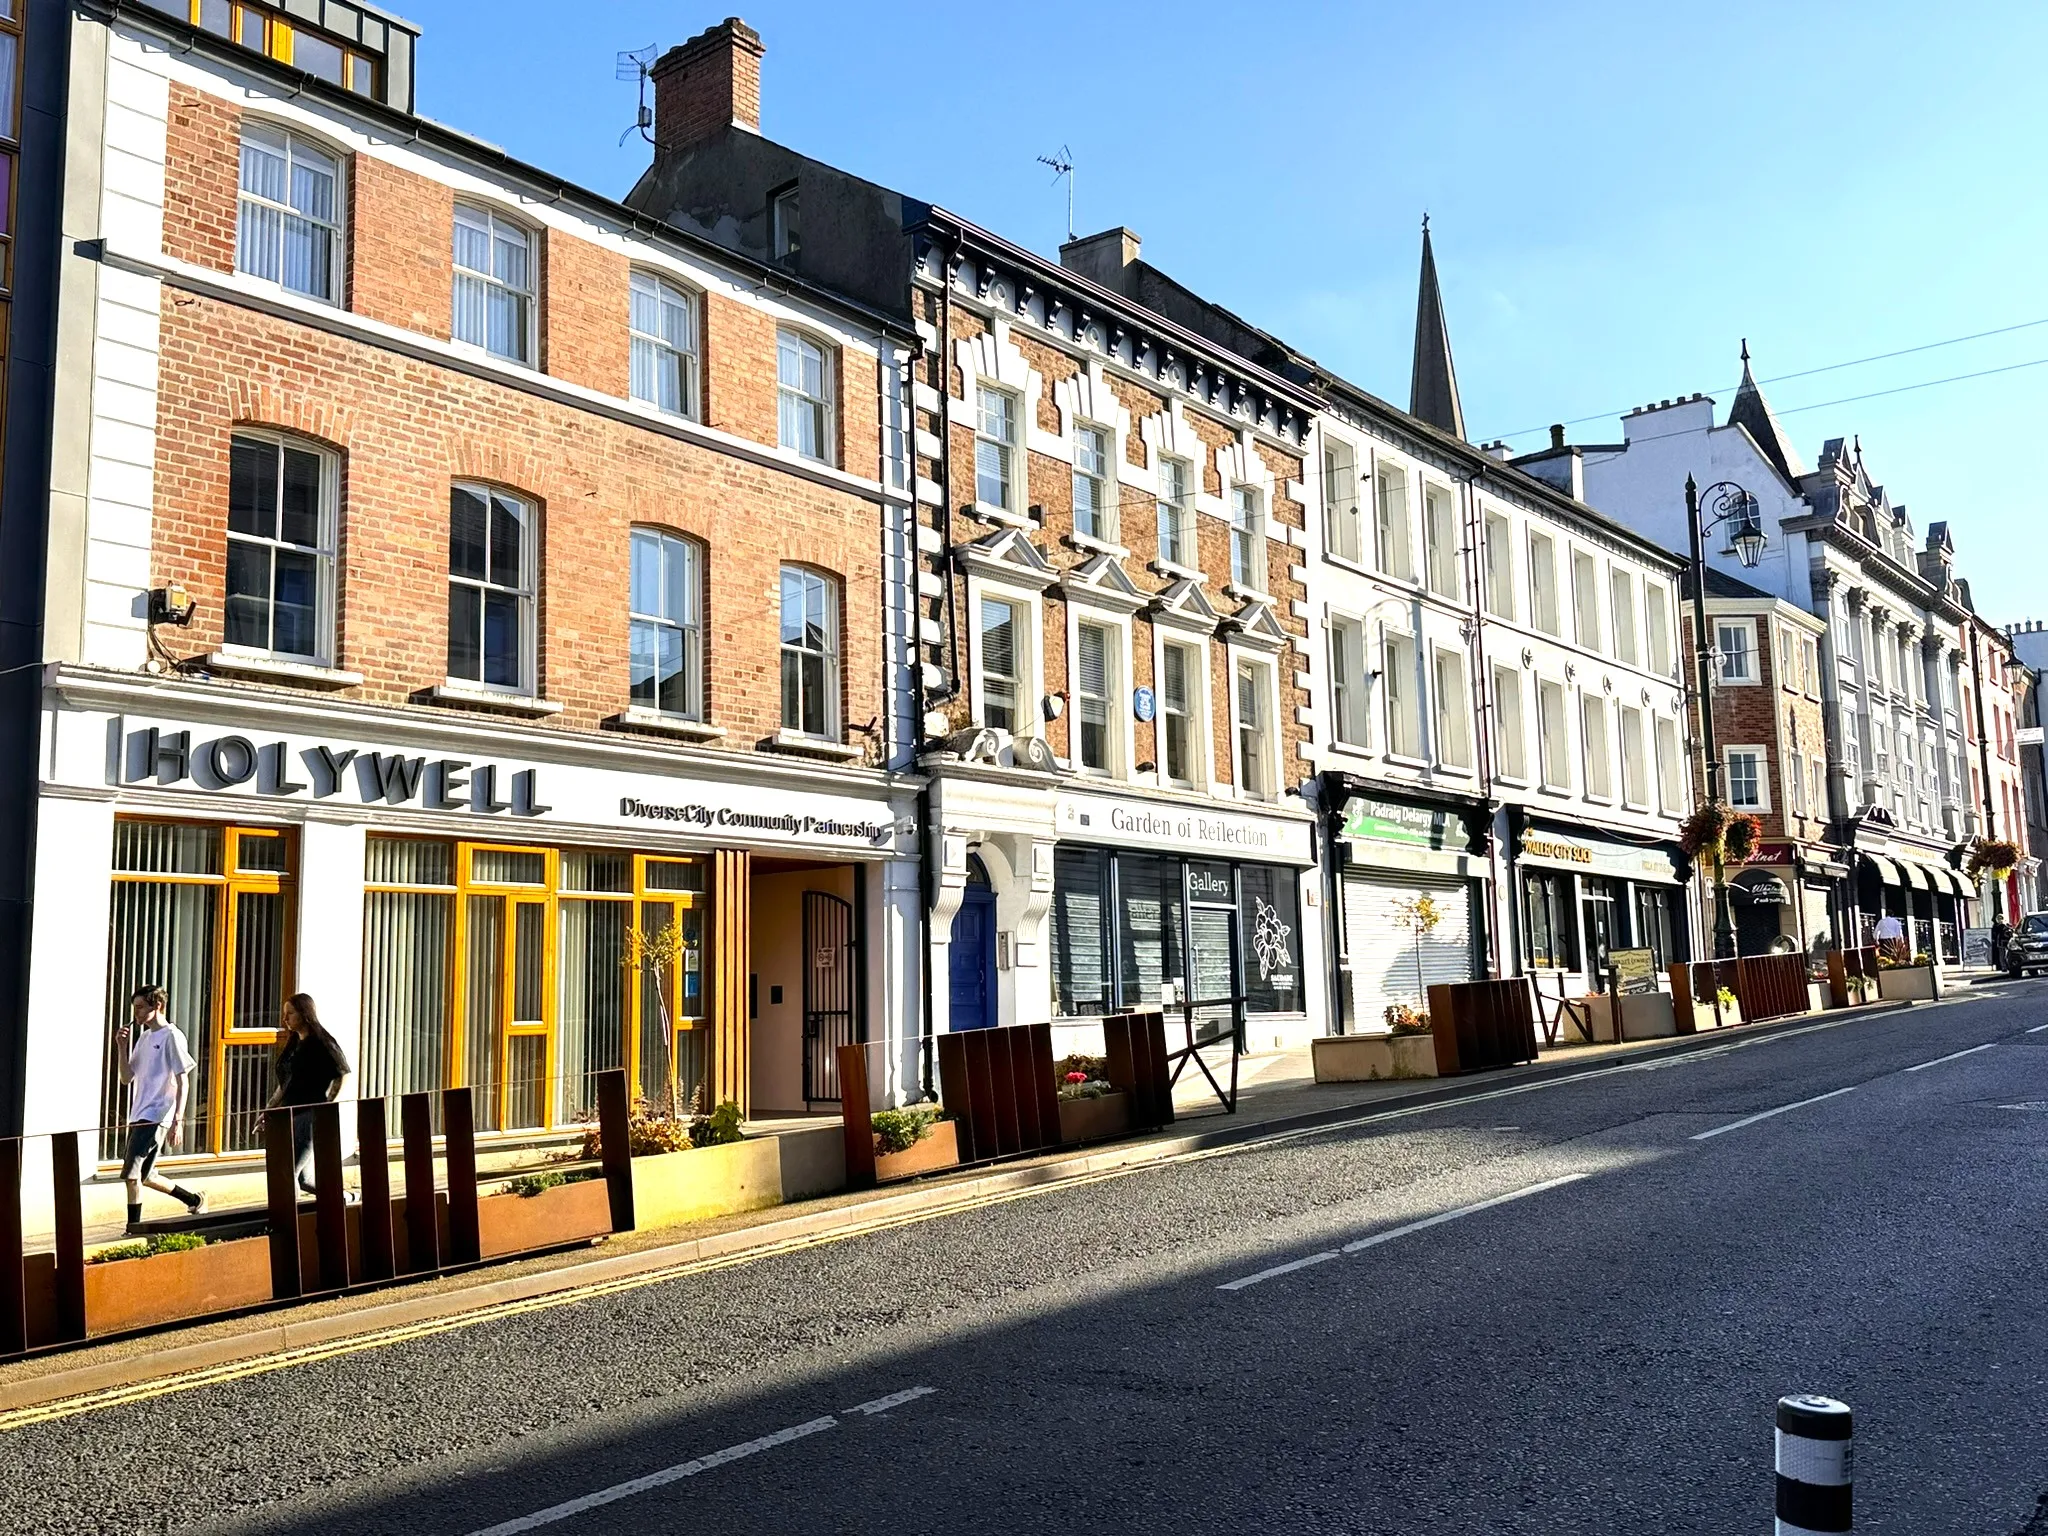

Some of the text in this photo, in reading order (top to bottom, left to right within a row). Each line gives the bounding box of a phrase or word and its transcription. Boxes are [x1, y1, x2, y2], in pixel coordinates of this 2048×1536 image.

[128, 726, 553, 816] HOLYWELL
[619, 796, 882, 840] DiverseCity Community Partnership
[1111, 807, 1172, 836] Garden
[1553, 843, 1573, 861] CITY
[1188, 871, 1230, 897] Gallery
